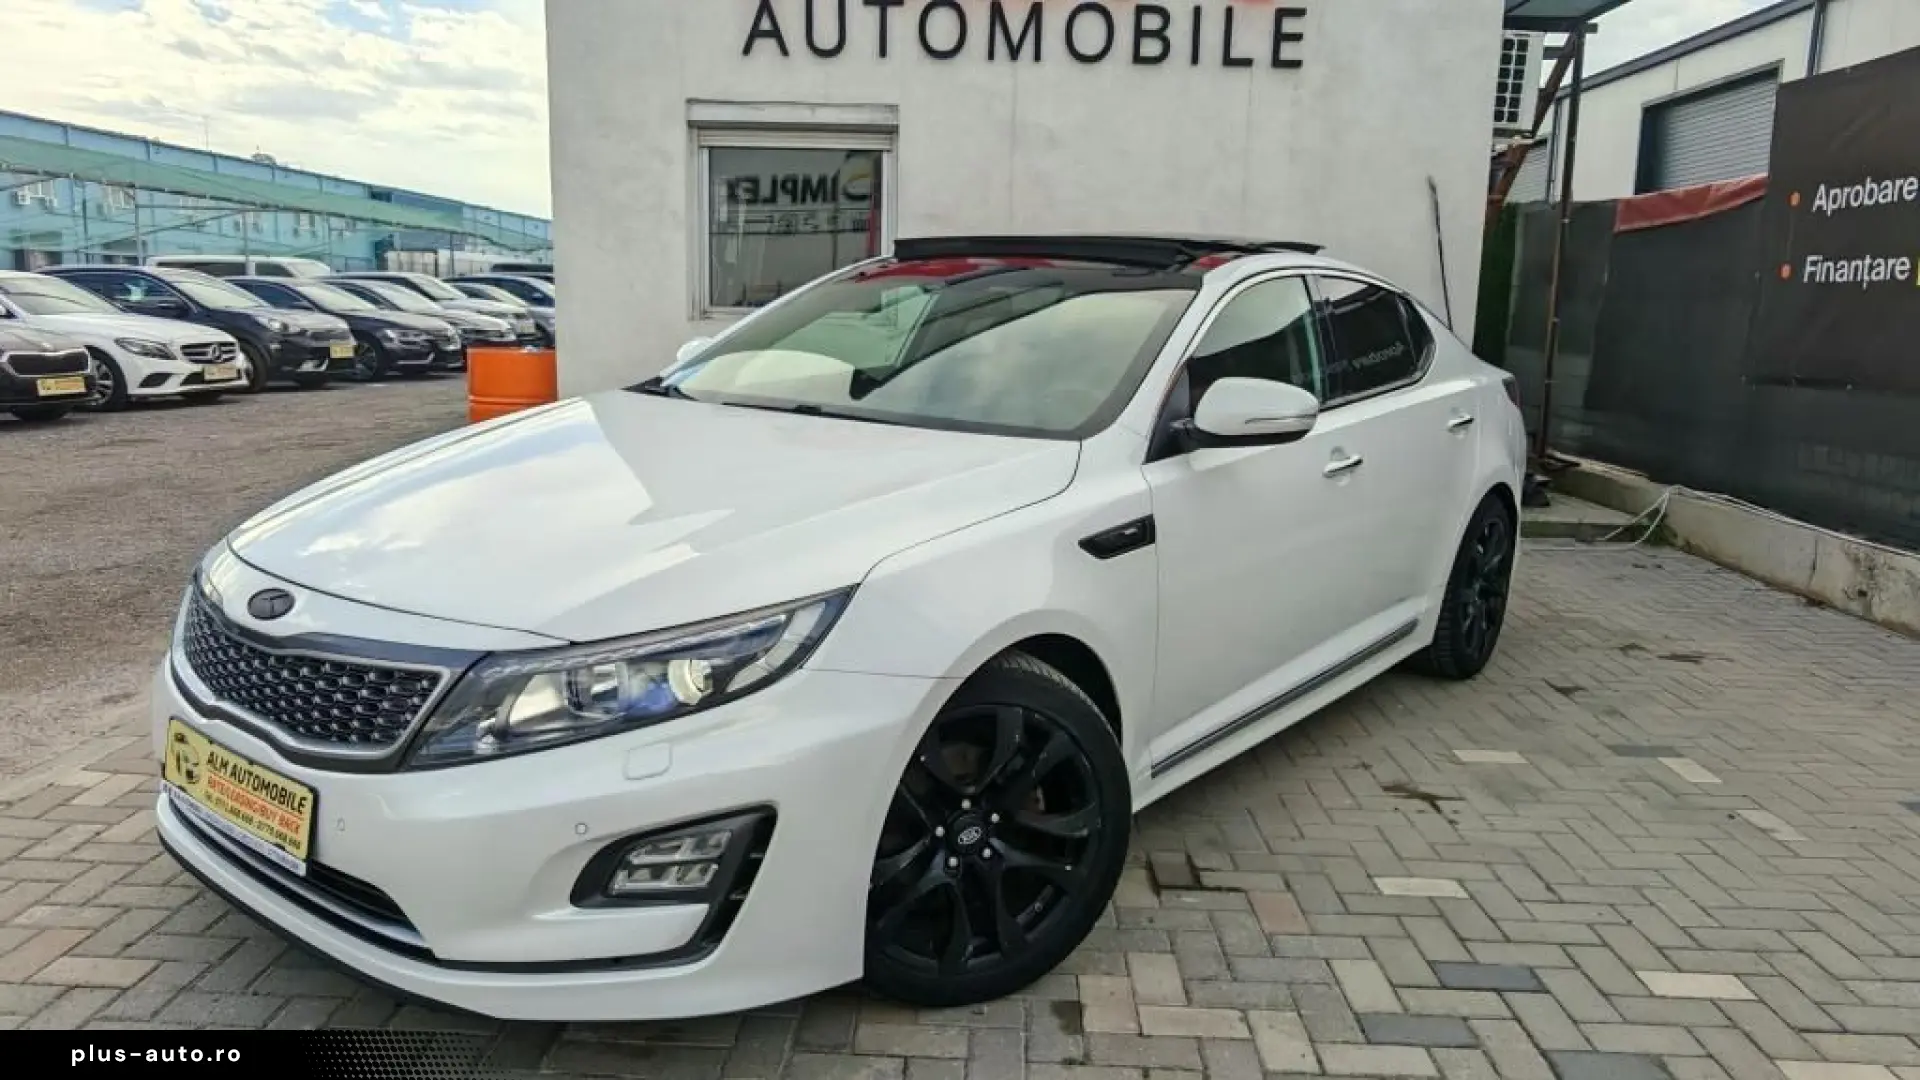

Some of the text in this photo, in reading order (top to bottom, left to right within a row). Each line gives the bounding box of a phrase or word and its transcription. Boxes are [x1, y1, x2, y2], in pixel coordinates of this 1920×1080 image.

[742, 0, 1307, 68] AUTOMOBILE
[1812, 176, 1918, 216] Aprobare
[1803, 255, 1911, 290] Finanțare
[207, 751, 307, 813] ALM AUTOMOBILE
